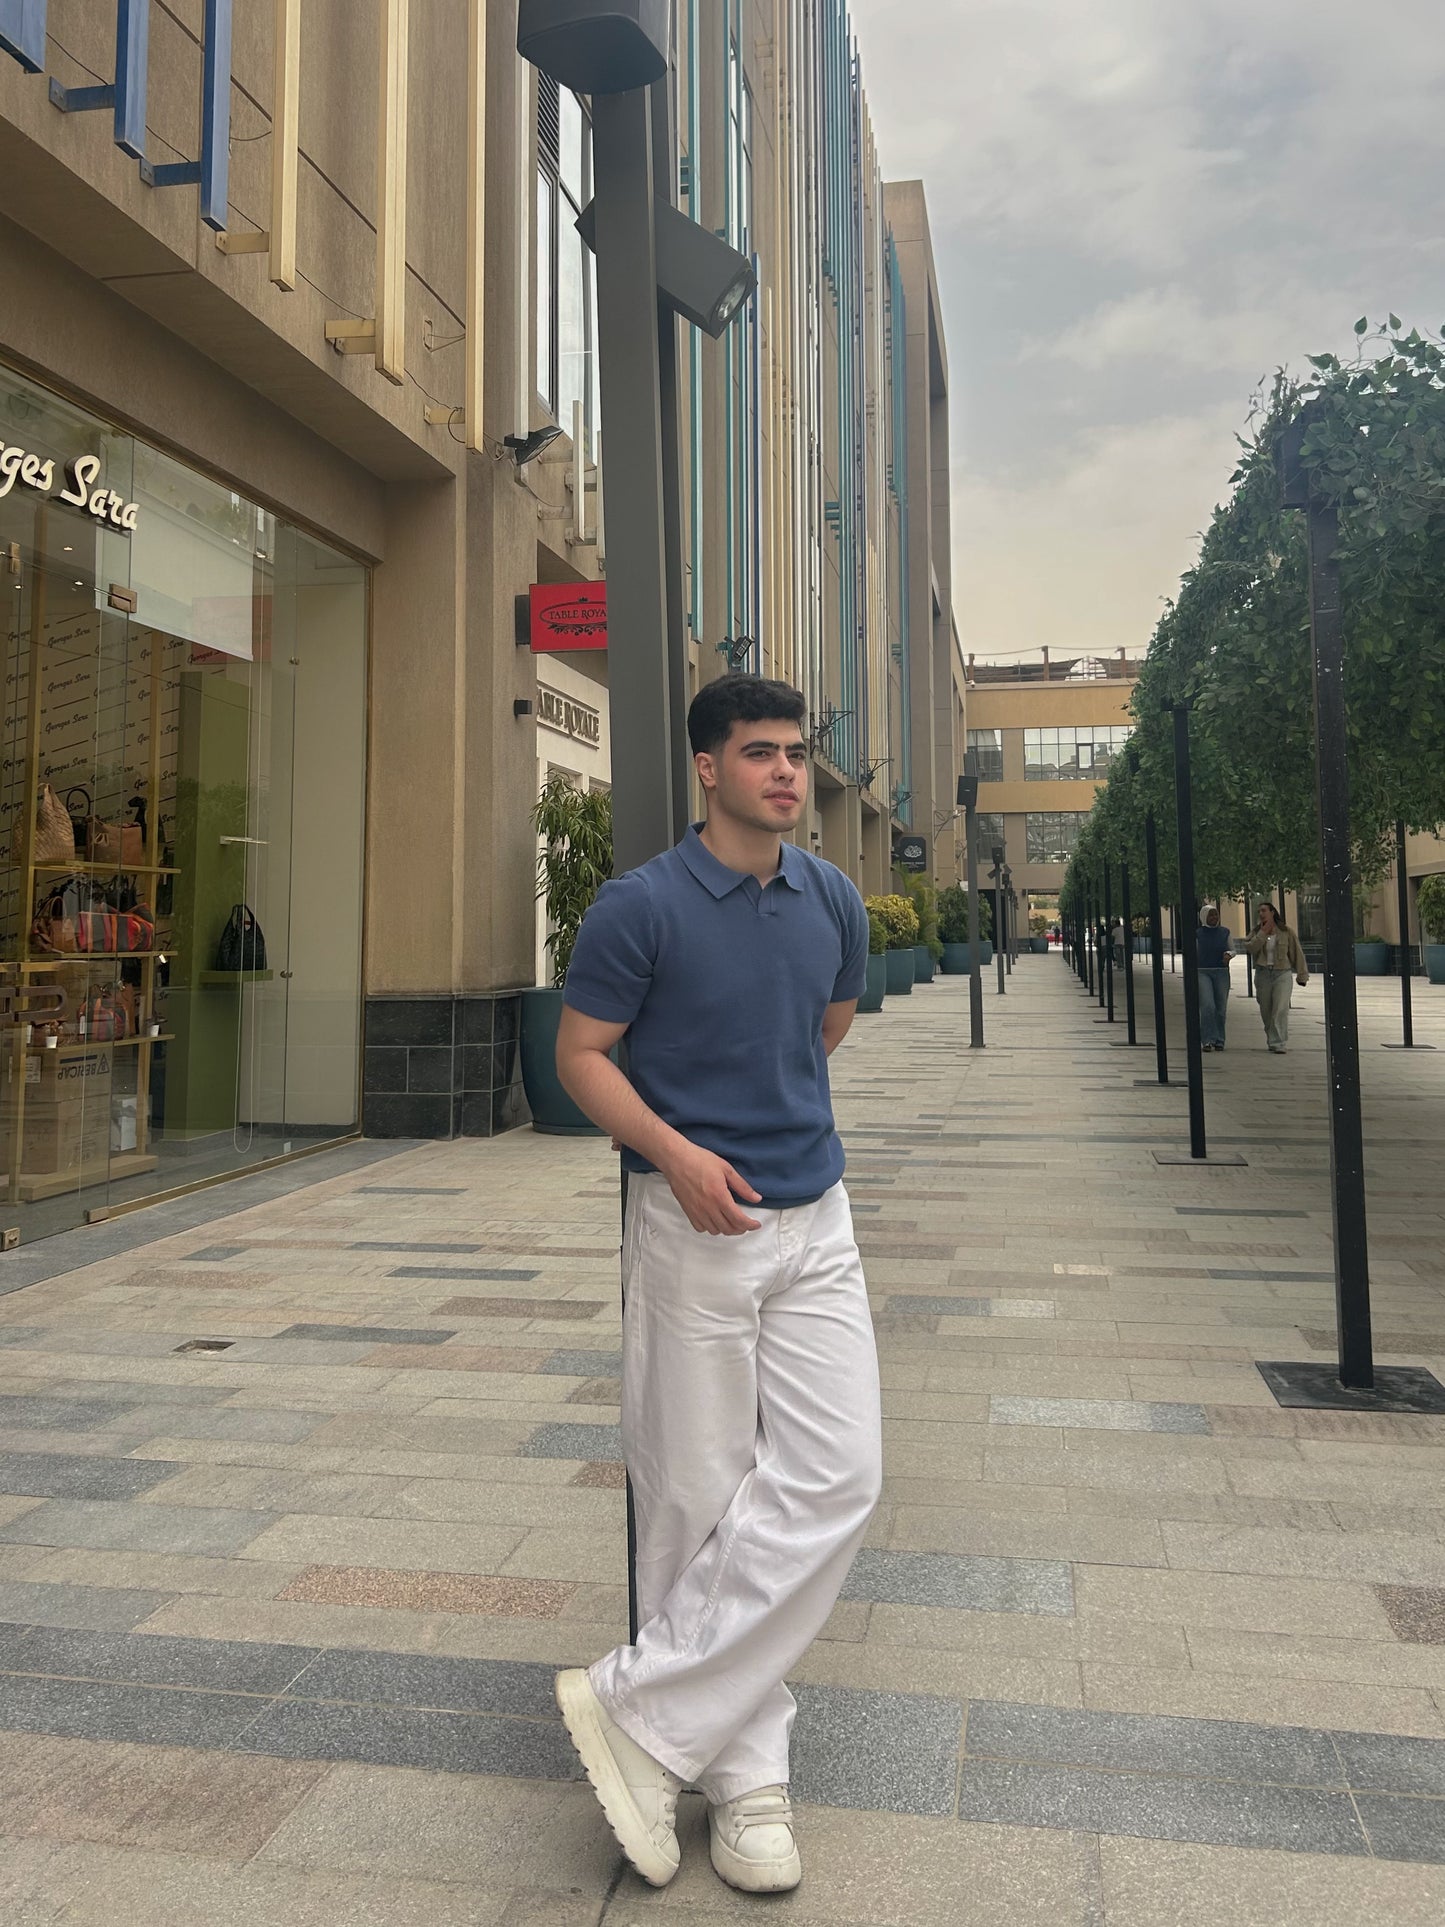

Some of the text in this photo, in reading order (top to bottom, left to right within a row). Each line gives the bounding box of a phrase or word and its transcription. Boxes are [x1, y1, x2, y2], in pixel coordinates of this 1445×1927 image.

[0, 441, 140, 530] ges Sara
[549, 609, 579, 620] TABLE
[564, 701, 600, 742] ROYALE
[57, 1063, 97, 1080] BERICAP
